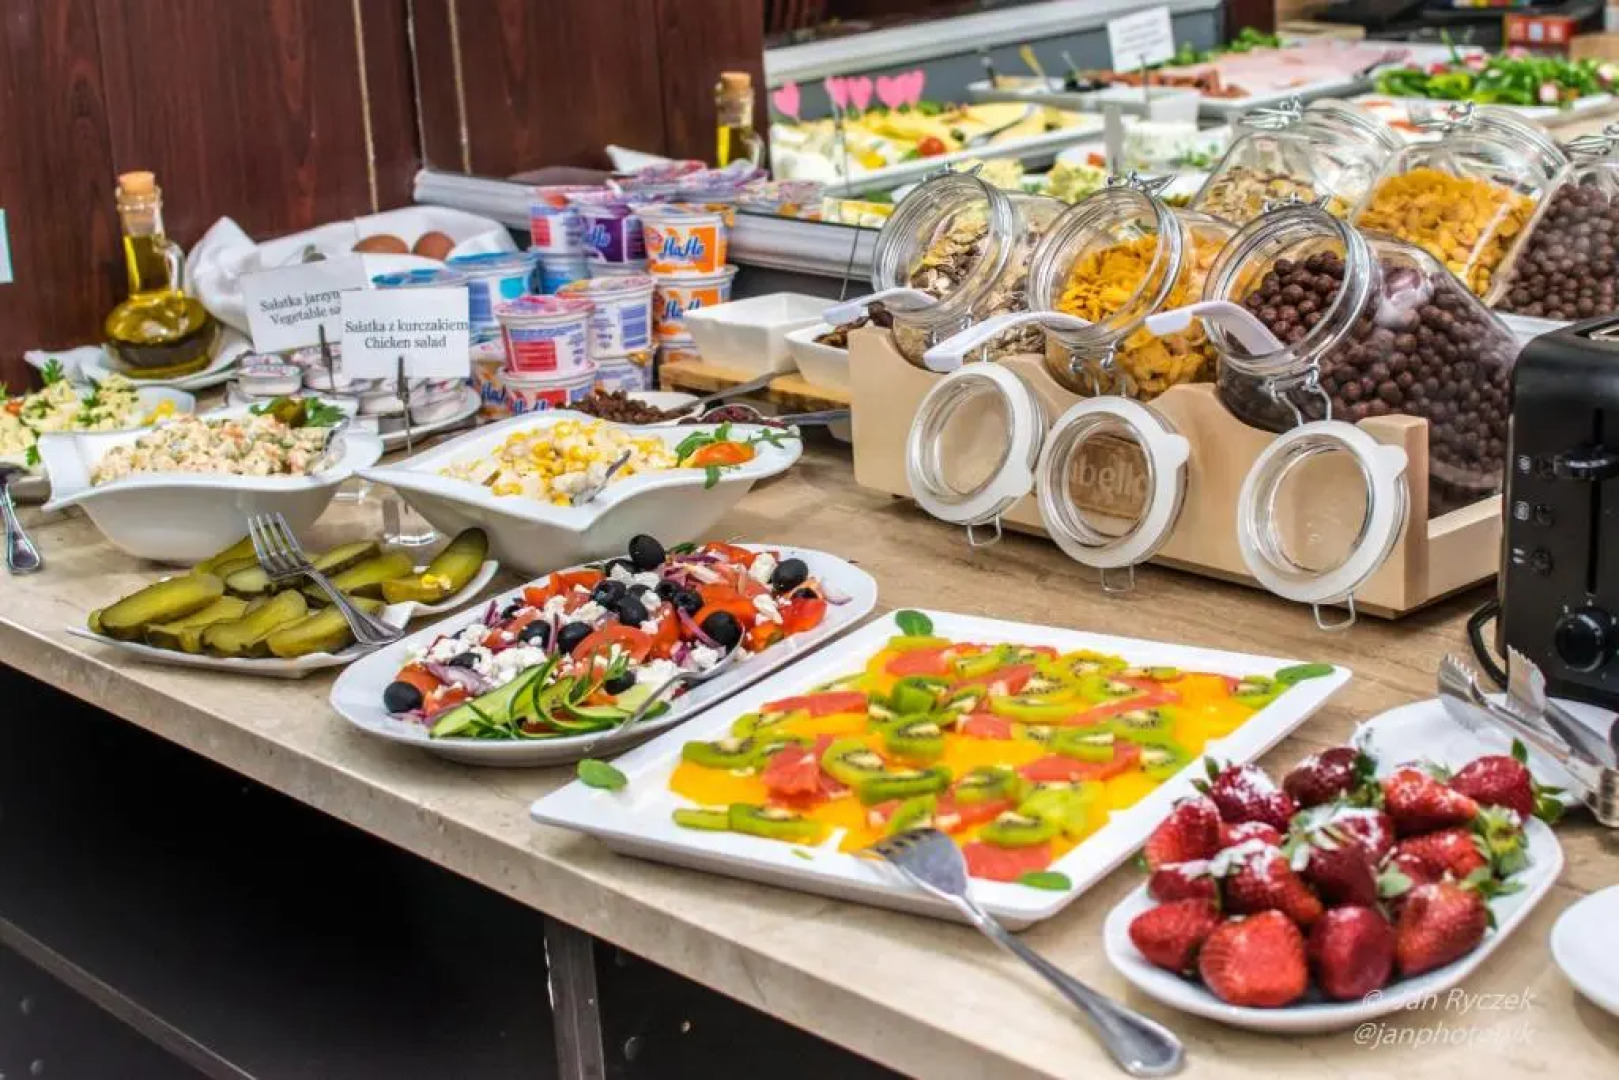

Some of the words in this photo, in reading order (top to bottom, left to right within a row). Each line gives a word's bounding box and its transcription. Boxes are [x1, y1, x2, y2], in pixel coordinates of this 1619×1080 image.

[260, 293, 302, 312] Sałatka
[304, 290, 341, 306] jarzyn
[270, 305, 327, 326] Vegetable
[330, 305, 342, 316] sa
[345, 319, 385, 333] Sałatka
[388, 322, 395, 332] z
[398, 317, 468, 332] kurczakiem
[365, 336, 411, 349] Chicken
[414, 335, 447, 348] salad
